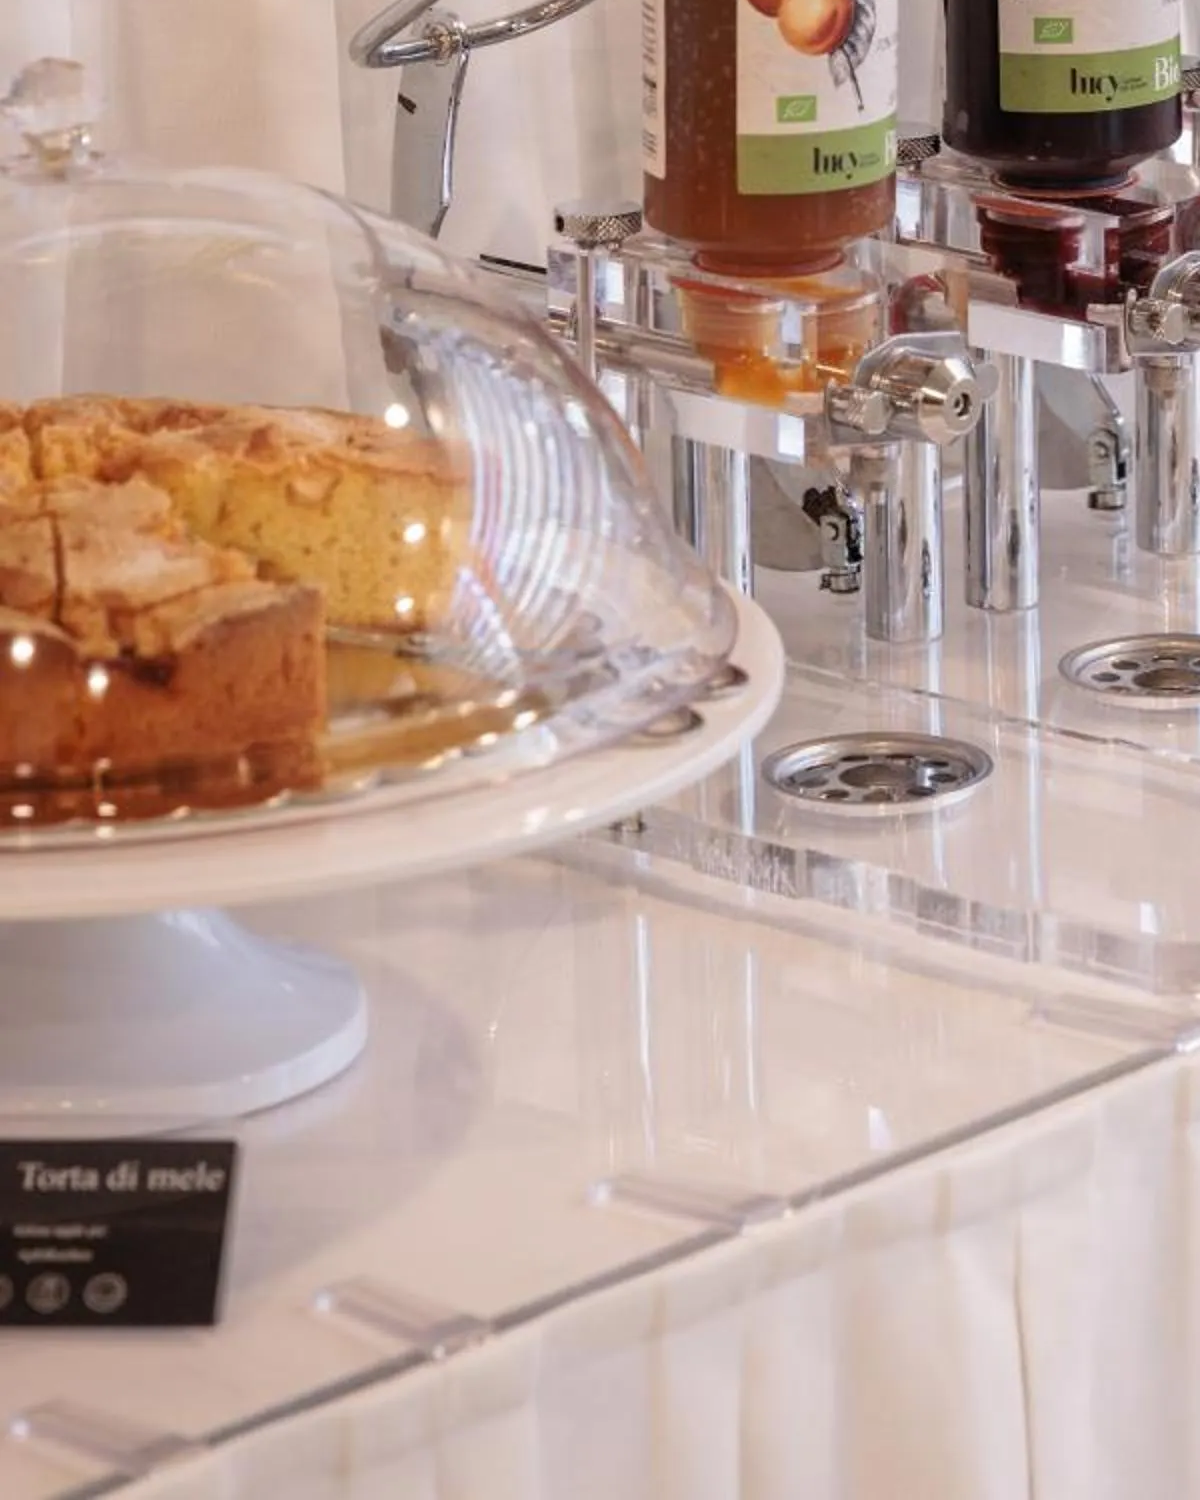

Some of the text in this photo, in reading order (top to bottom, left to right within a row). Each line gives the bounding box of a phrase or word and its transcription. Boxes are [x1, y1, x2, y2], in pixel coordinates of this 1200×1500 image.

[18, 1160, 226, 1192] Torta di mele
